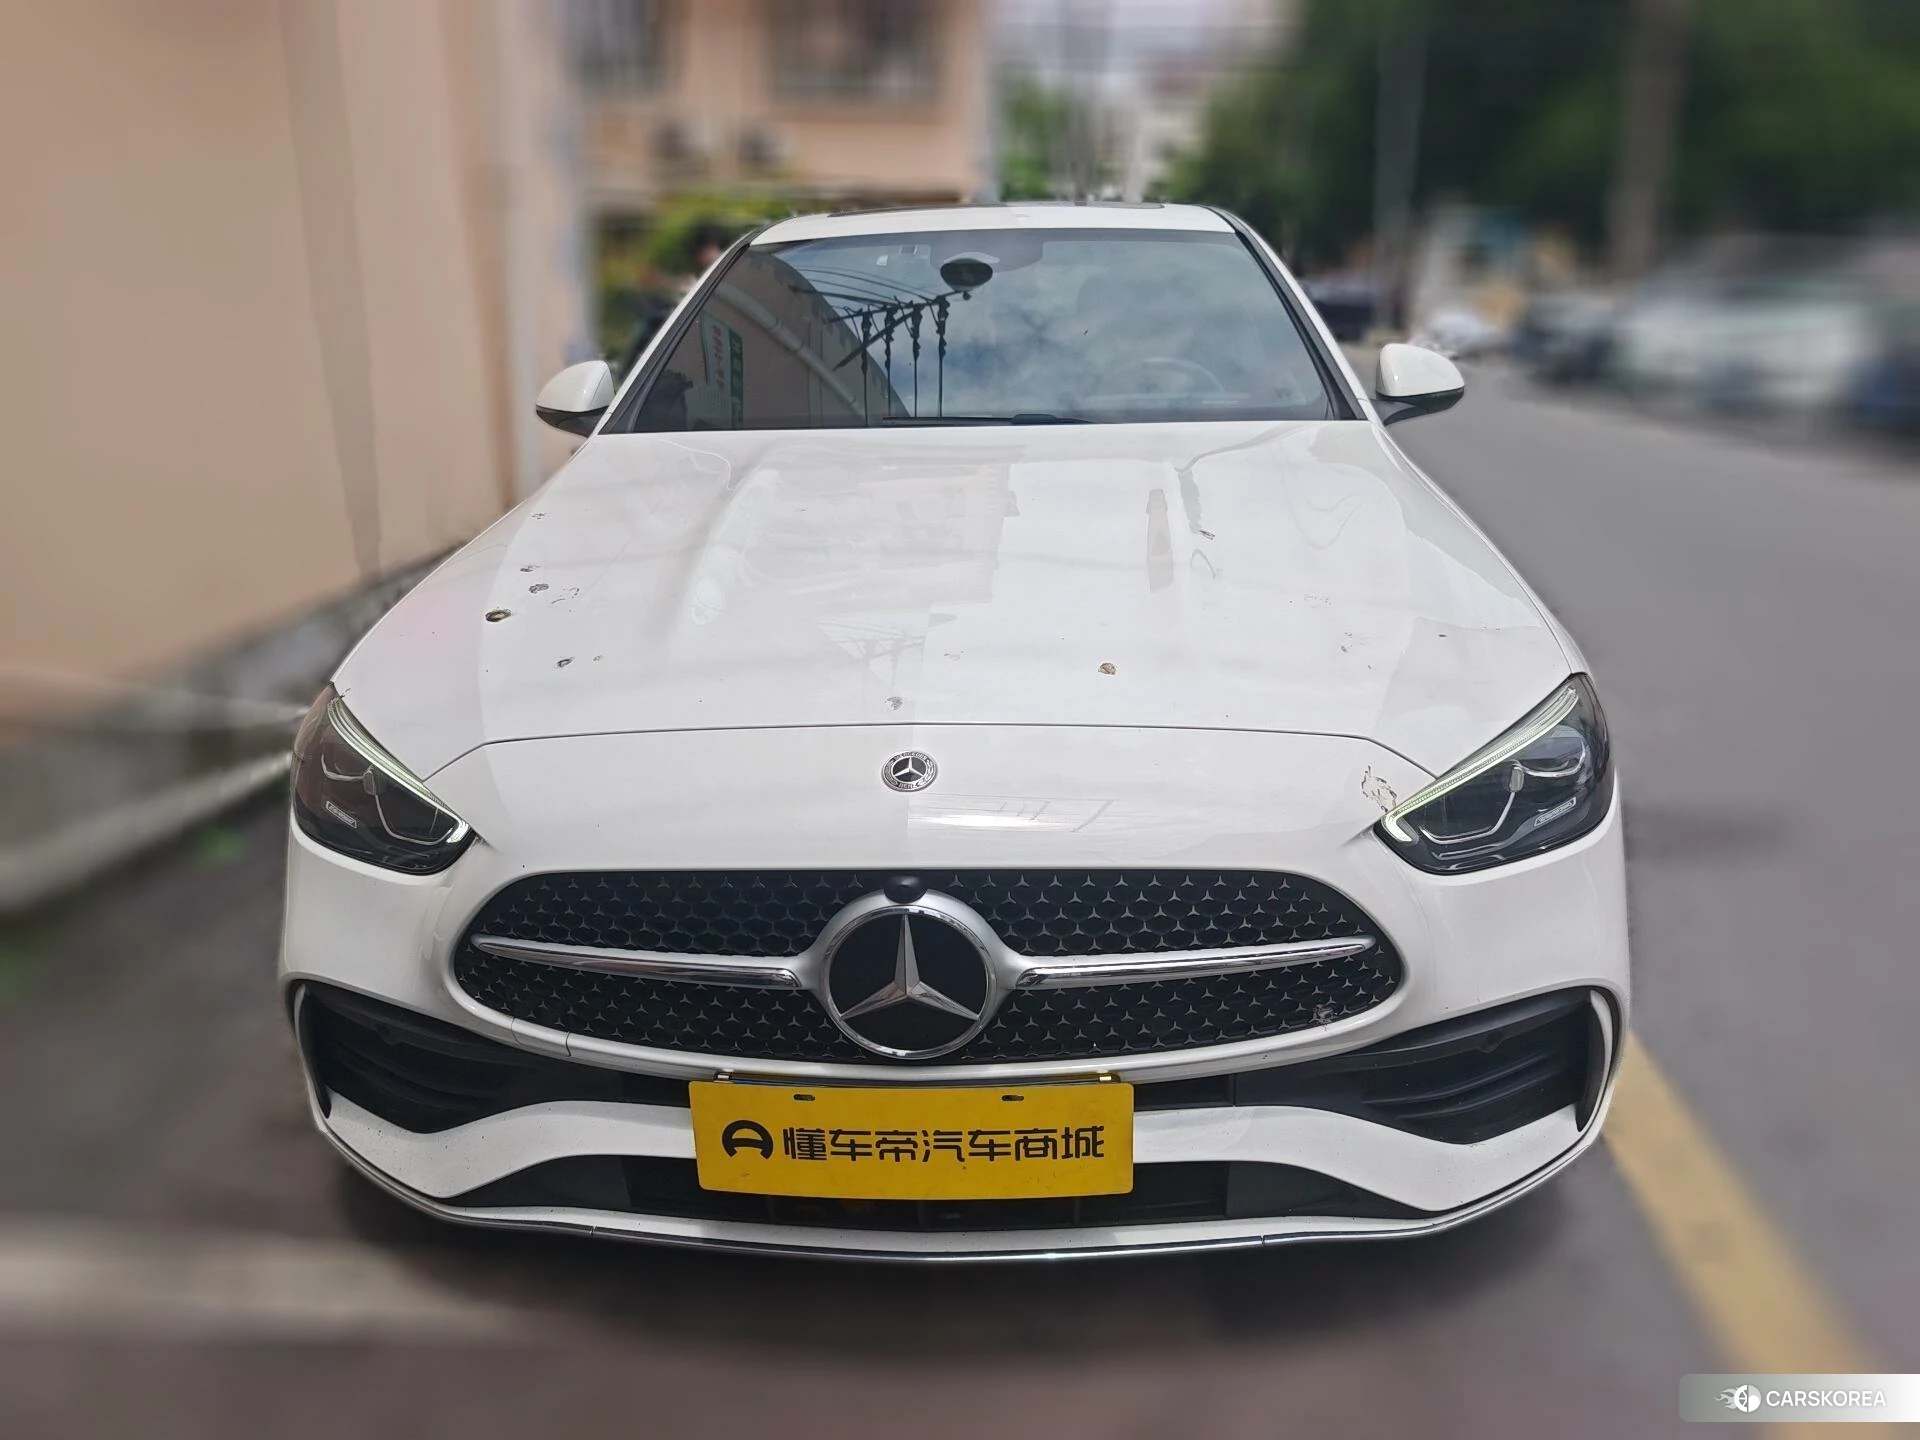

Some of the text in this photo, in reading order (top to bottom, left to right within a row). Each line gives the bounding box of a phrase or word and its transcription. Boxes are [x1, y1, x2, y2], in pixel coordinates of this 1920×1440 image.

[783, 1125, 1105, 1162] 懂车帝汽车商城
